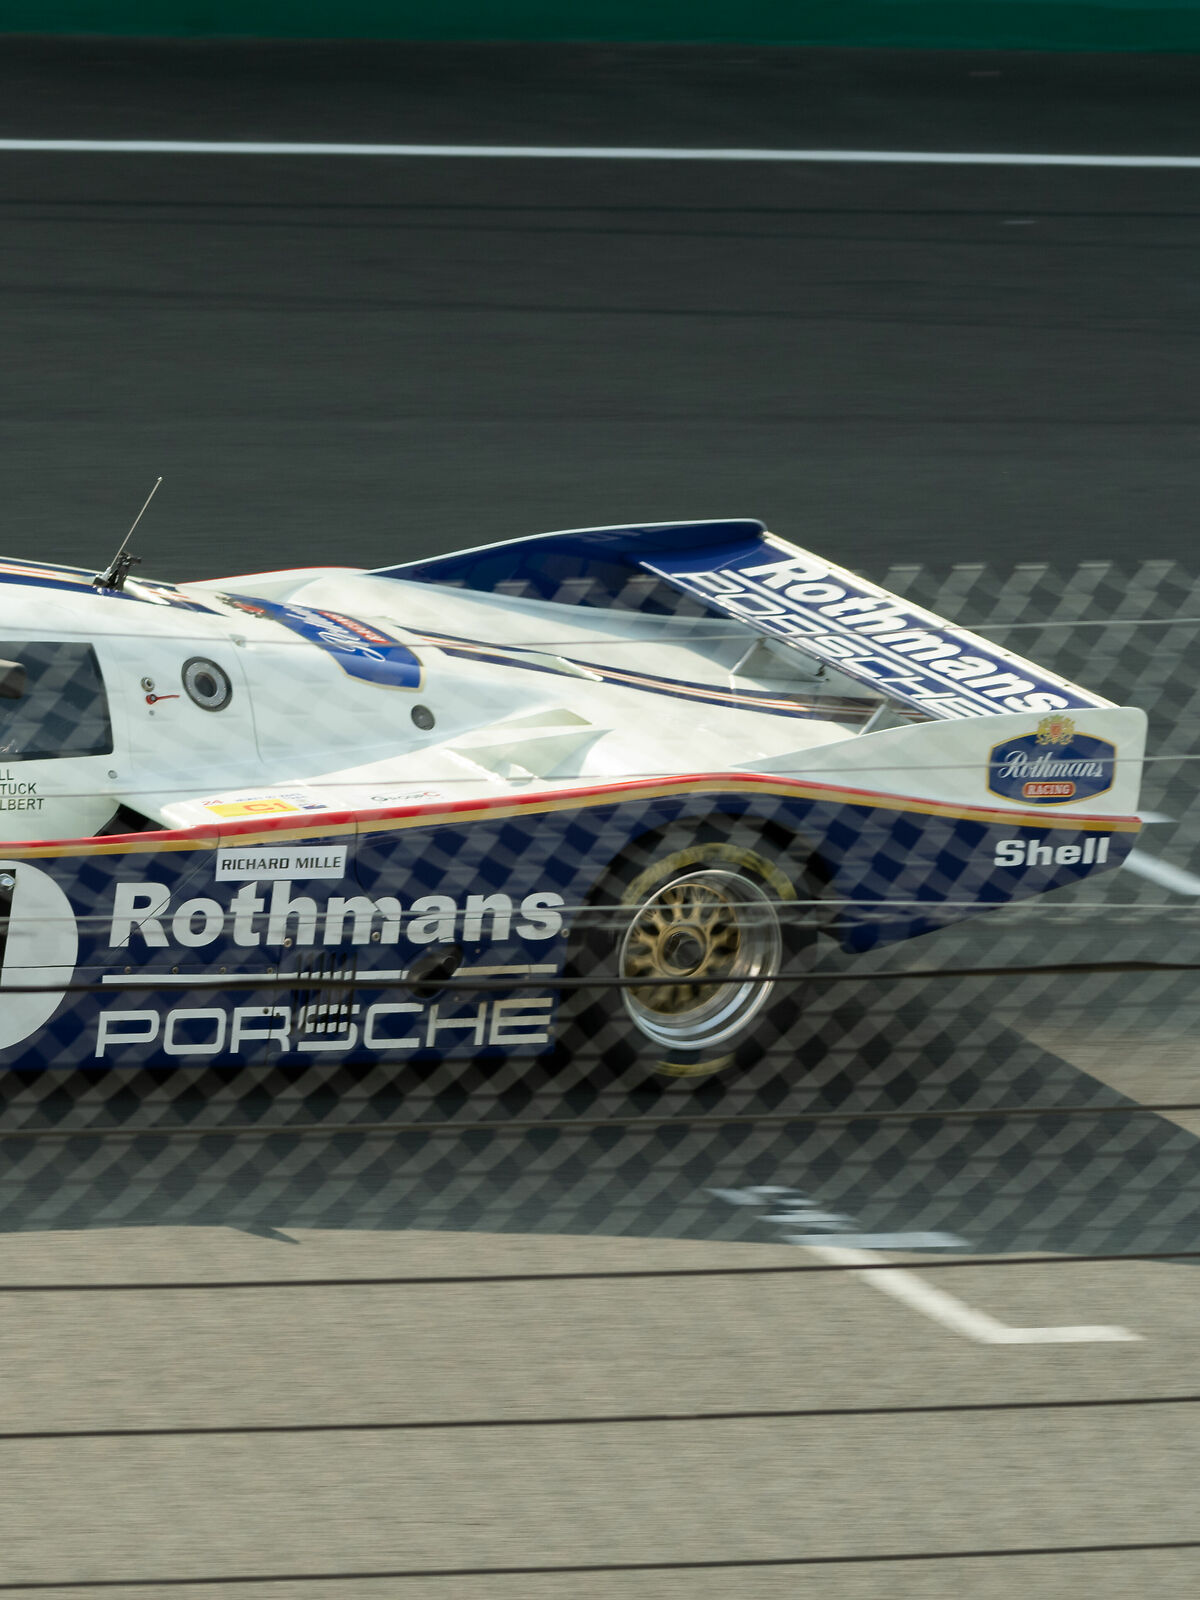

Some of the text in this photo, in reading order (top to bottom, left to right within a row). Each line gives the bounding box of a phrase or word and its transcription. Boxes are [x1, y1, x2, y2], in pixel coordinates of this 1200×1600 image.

[740, 559, 1069, 713] Rothmans
[998, 750, 1104, 778] Rothmans
[1026, 784, 1072, 795] RACING
[221, 856, 342, 870] RICHARD MILLE
[993, 837, 1111, 867] Shell
[108, 880, 566, 949] Rothmans
[95, 997, 553, 1058] PORSCHE
